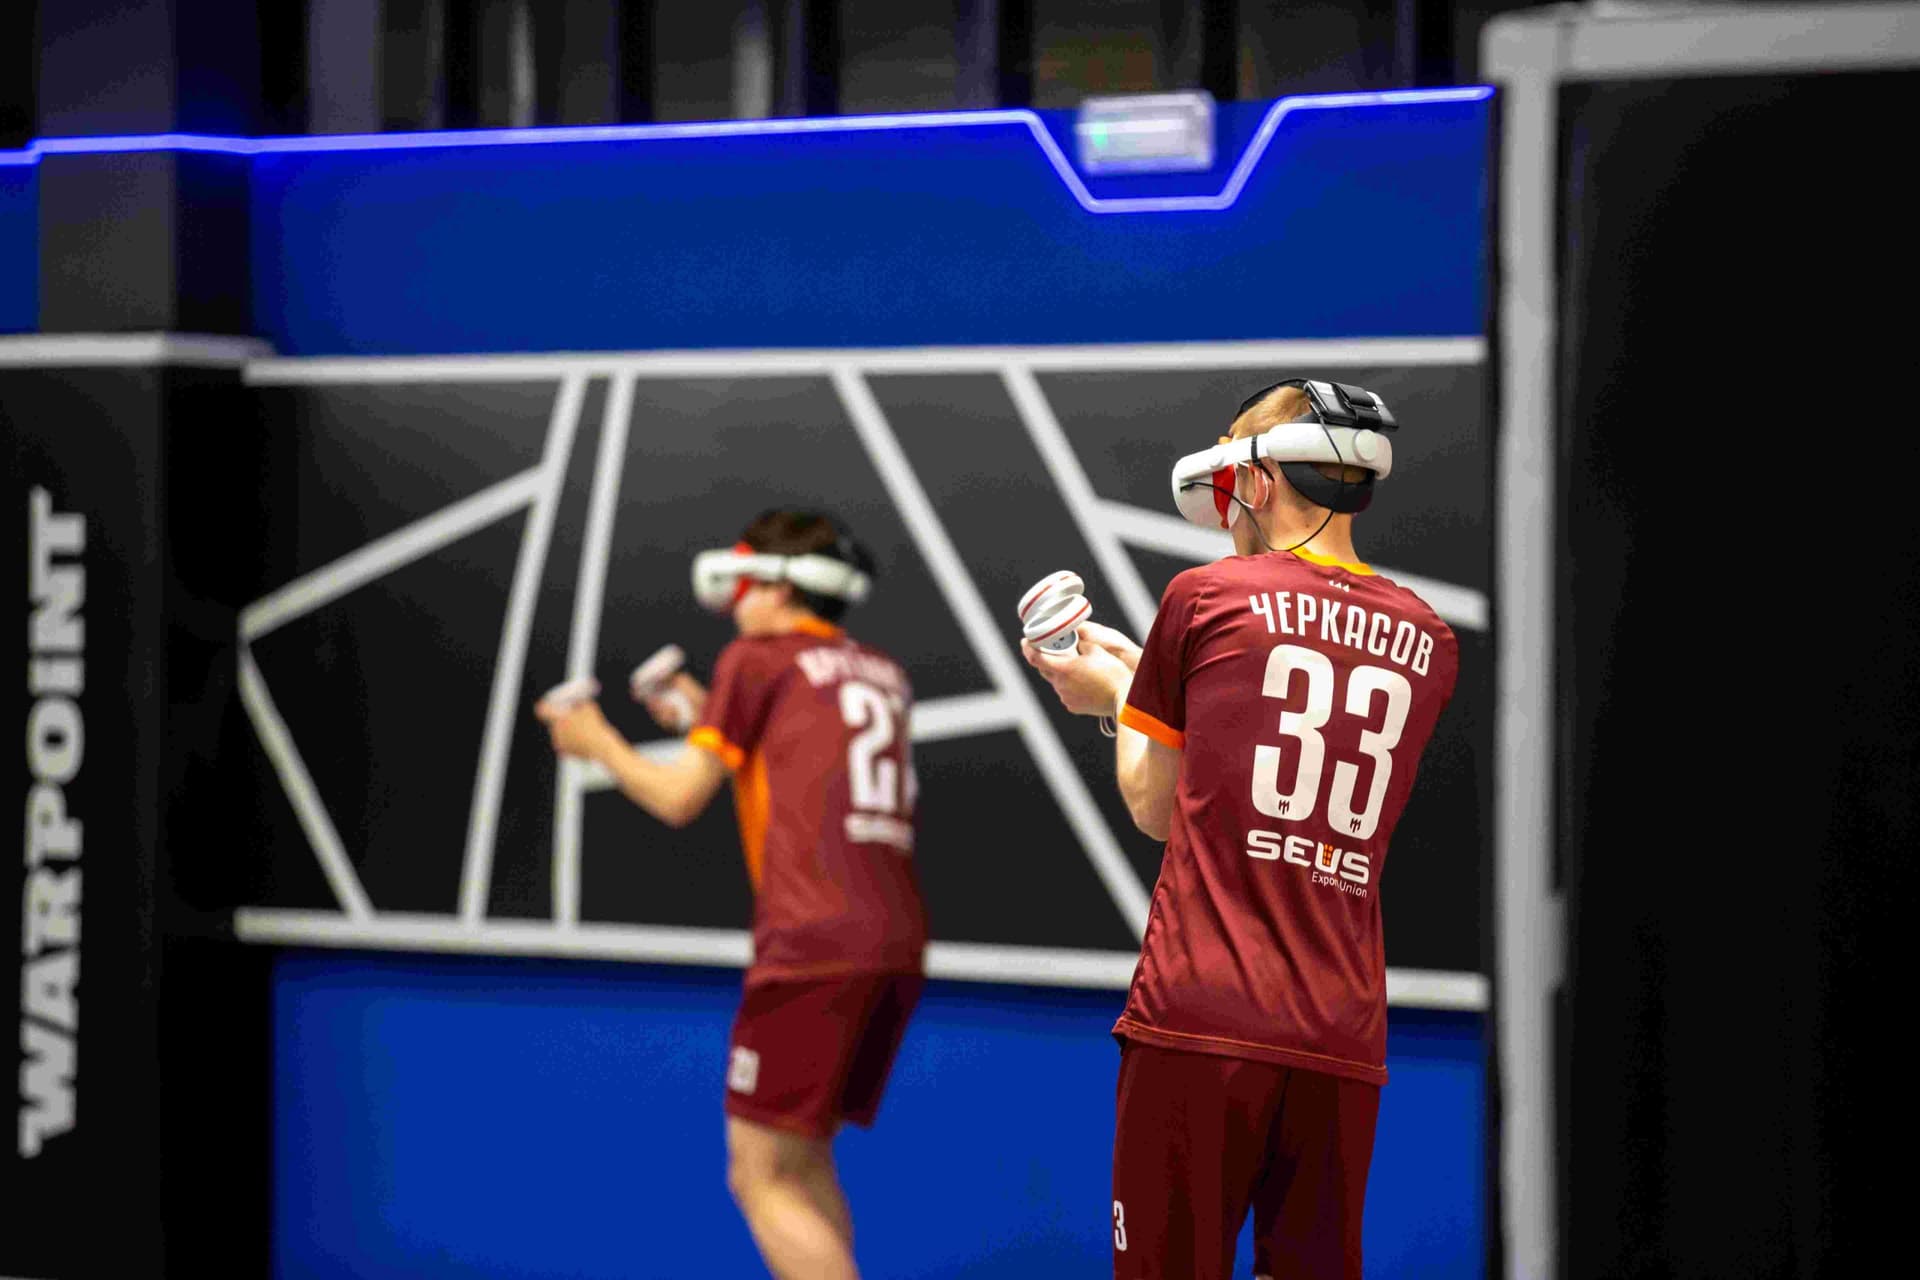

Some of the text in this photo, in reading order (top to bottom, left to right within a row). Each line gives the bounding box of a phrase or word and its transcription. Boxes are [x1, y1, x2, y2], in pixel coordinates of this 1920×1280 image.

[1249, 591, 1434, 677] ЧЕРКАСОВ
[1251, 644, 1412, 841] 33
[19, 485, 86, 1157] WARPOINT
[1246, 829, 1370, 884] SEUS
[1113, 1200, 1128, 1252] 3
